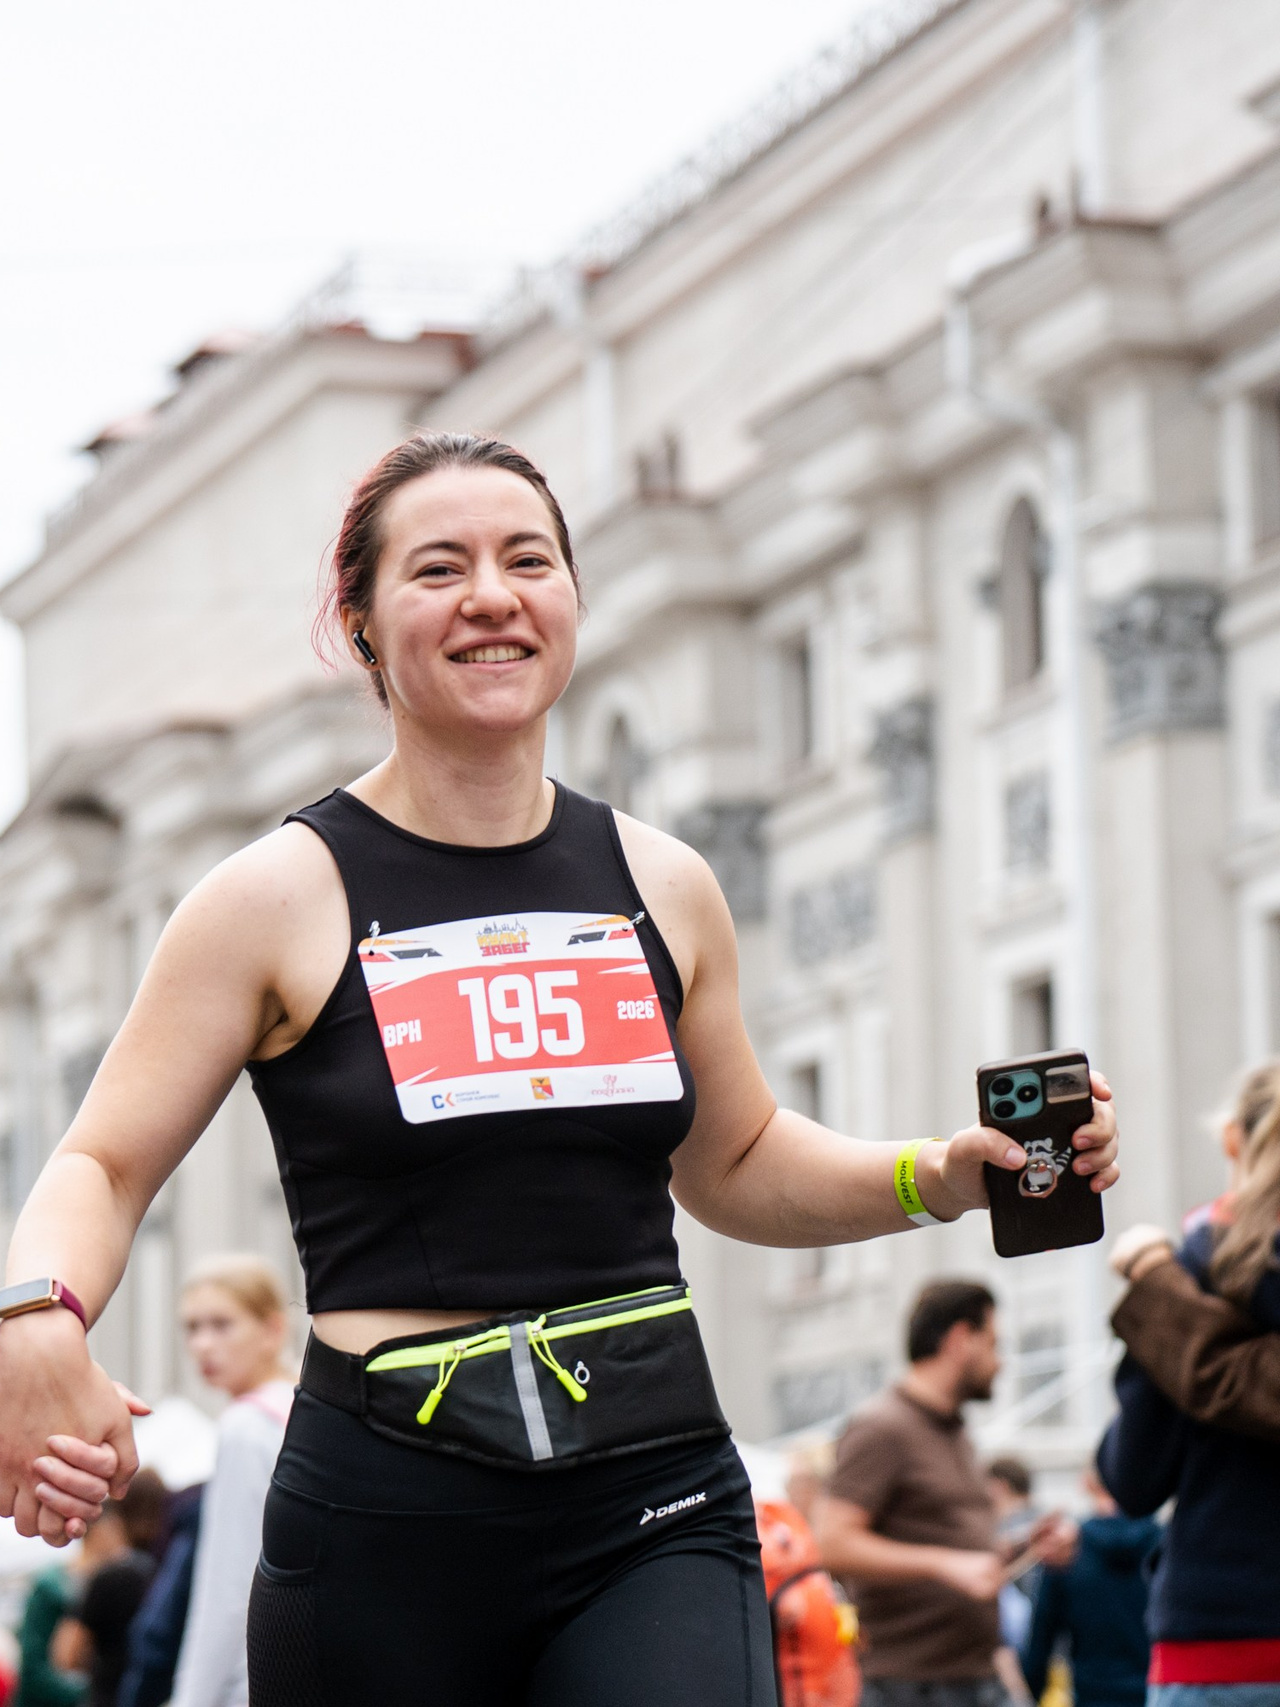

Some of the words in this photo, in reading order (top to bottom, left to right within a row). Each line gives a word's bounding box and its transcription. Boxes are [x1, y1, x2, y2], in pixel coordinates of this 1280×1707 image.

[457, 970, 586, 1063] 195
[617, 1000, 655, 1020] 2026
[383, 1019, 422, 1048] ВРН
[900, 1161, 913, 1205] MOLVEST
[655, 1491, 707, 1519] DEMIX
